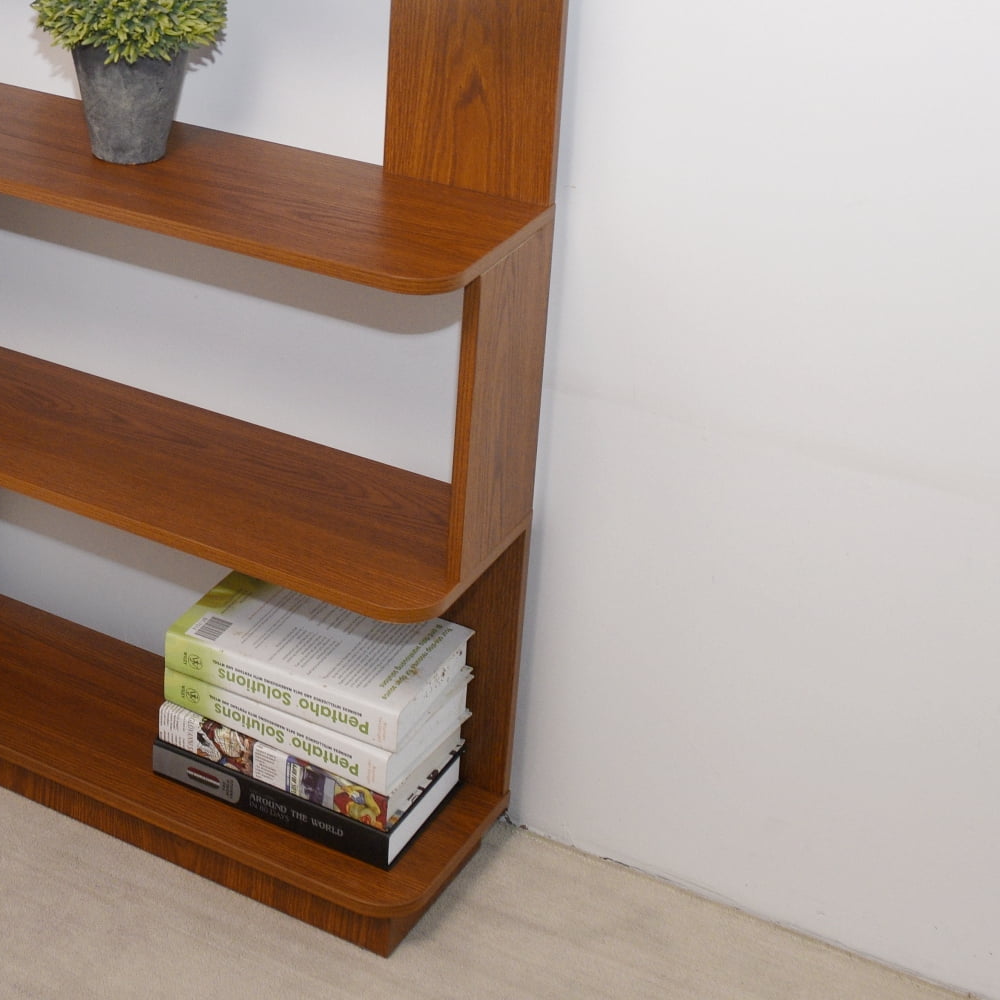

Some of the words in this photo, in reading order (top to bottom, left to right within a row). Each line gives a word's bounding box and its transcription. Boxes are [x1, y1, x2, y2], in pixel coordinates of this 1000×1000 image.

[218, 668, 291, 706] Solutions
[214, 703, 284, 744] Solutions
[298, 698, 369, 735] Pentaho
[291, 737, 359, 776] Pentaho
[250, 793, 288, 813] AROUND
[291, 808, 308, 822] THE
[310, 817, 344, 837] WORLD
